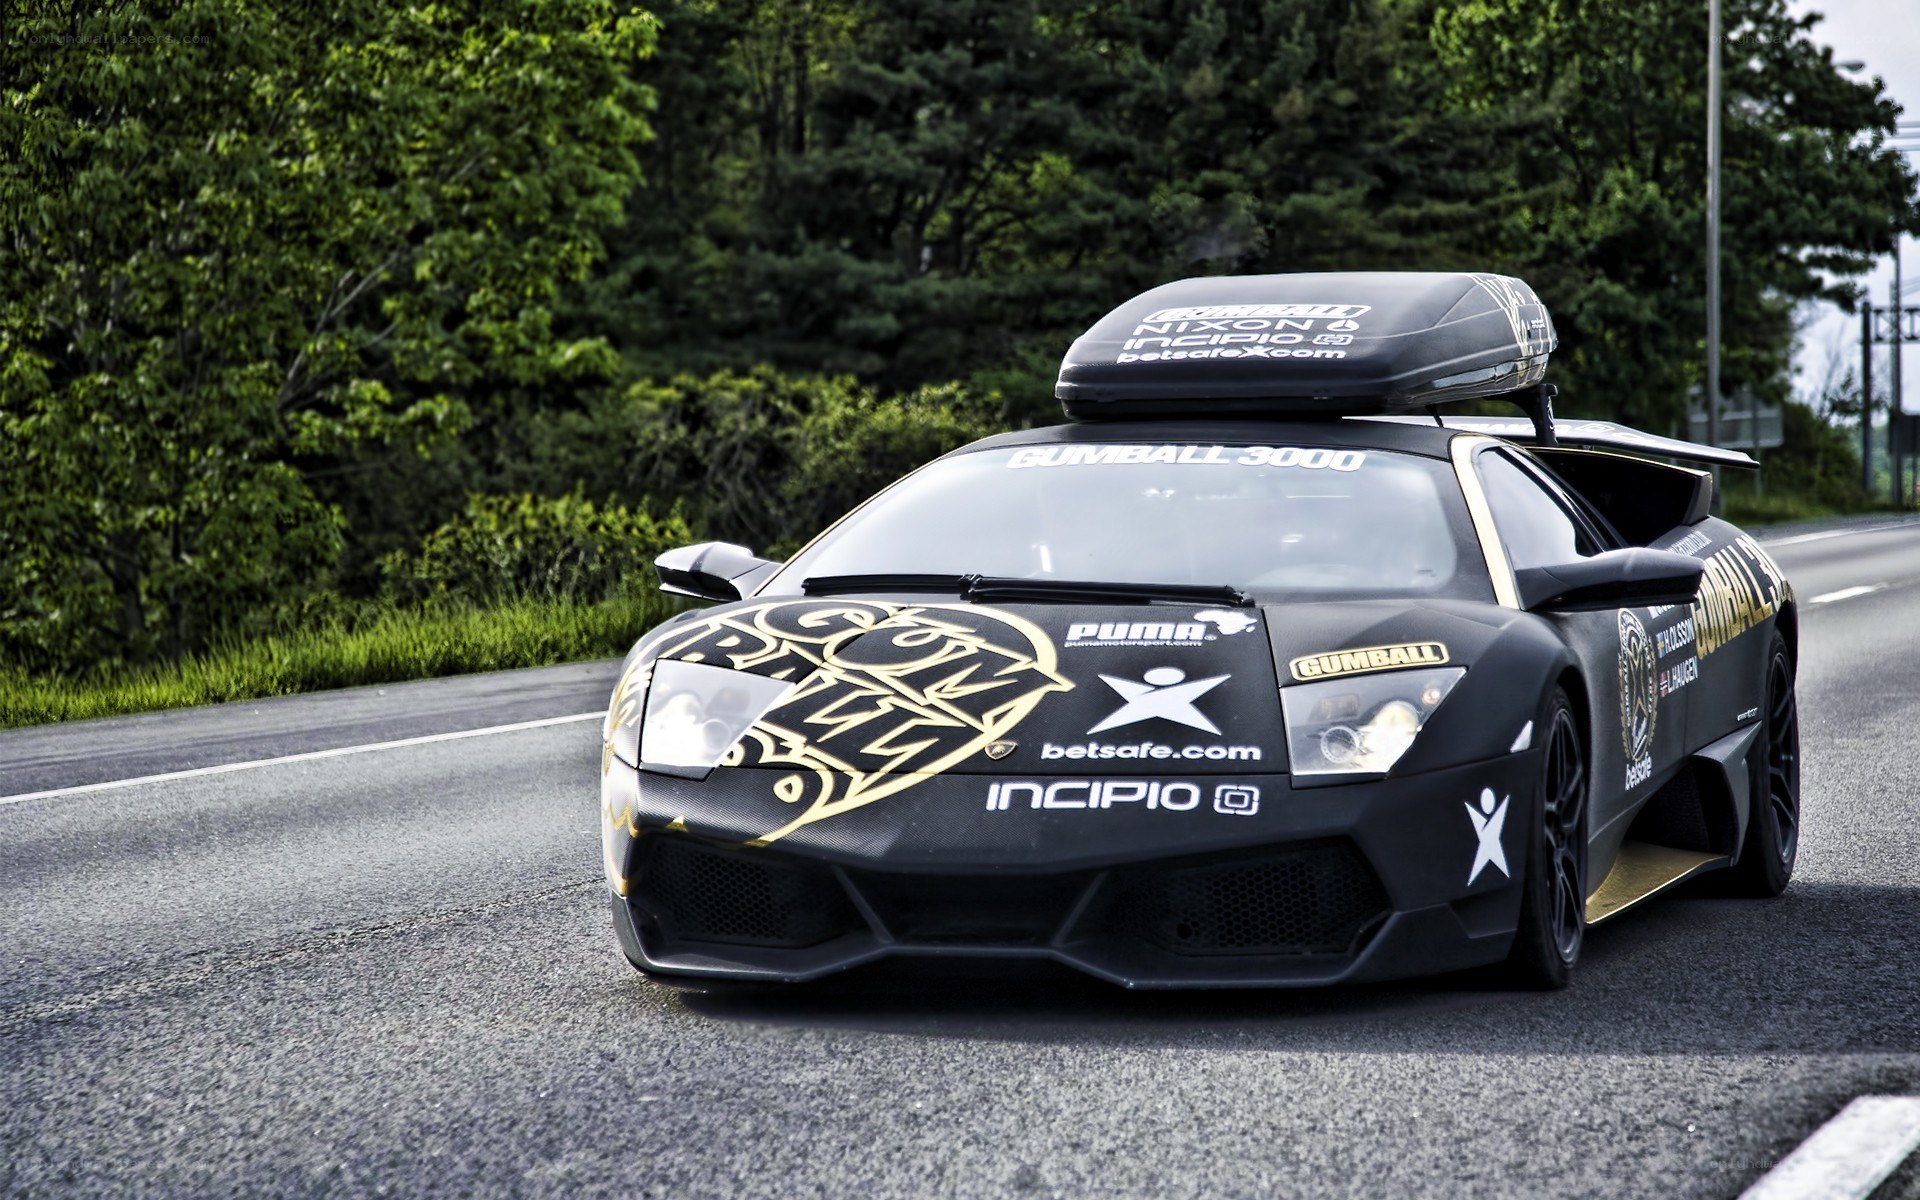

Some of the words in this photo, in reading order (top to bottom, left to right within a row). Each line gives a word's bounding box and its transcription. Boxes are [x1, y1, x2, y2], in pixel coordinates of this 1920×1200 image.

[1158, 304, 1348, 320] GUMBALL
[1133, 319, 1314, 335] NIXON
[1006, 445, 1230, 468] GUMBALL
[1237, 446, 1366, 471] 3000
[1066, 623, 1208, 641] PUMA
[1298, 645, 1440, 677] GUMBALL
[1041, 742, 1261, 760] betsafe.com
[1625, 751, 1652, 790] betsafe
